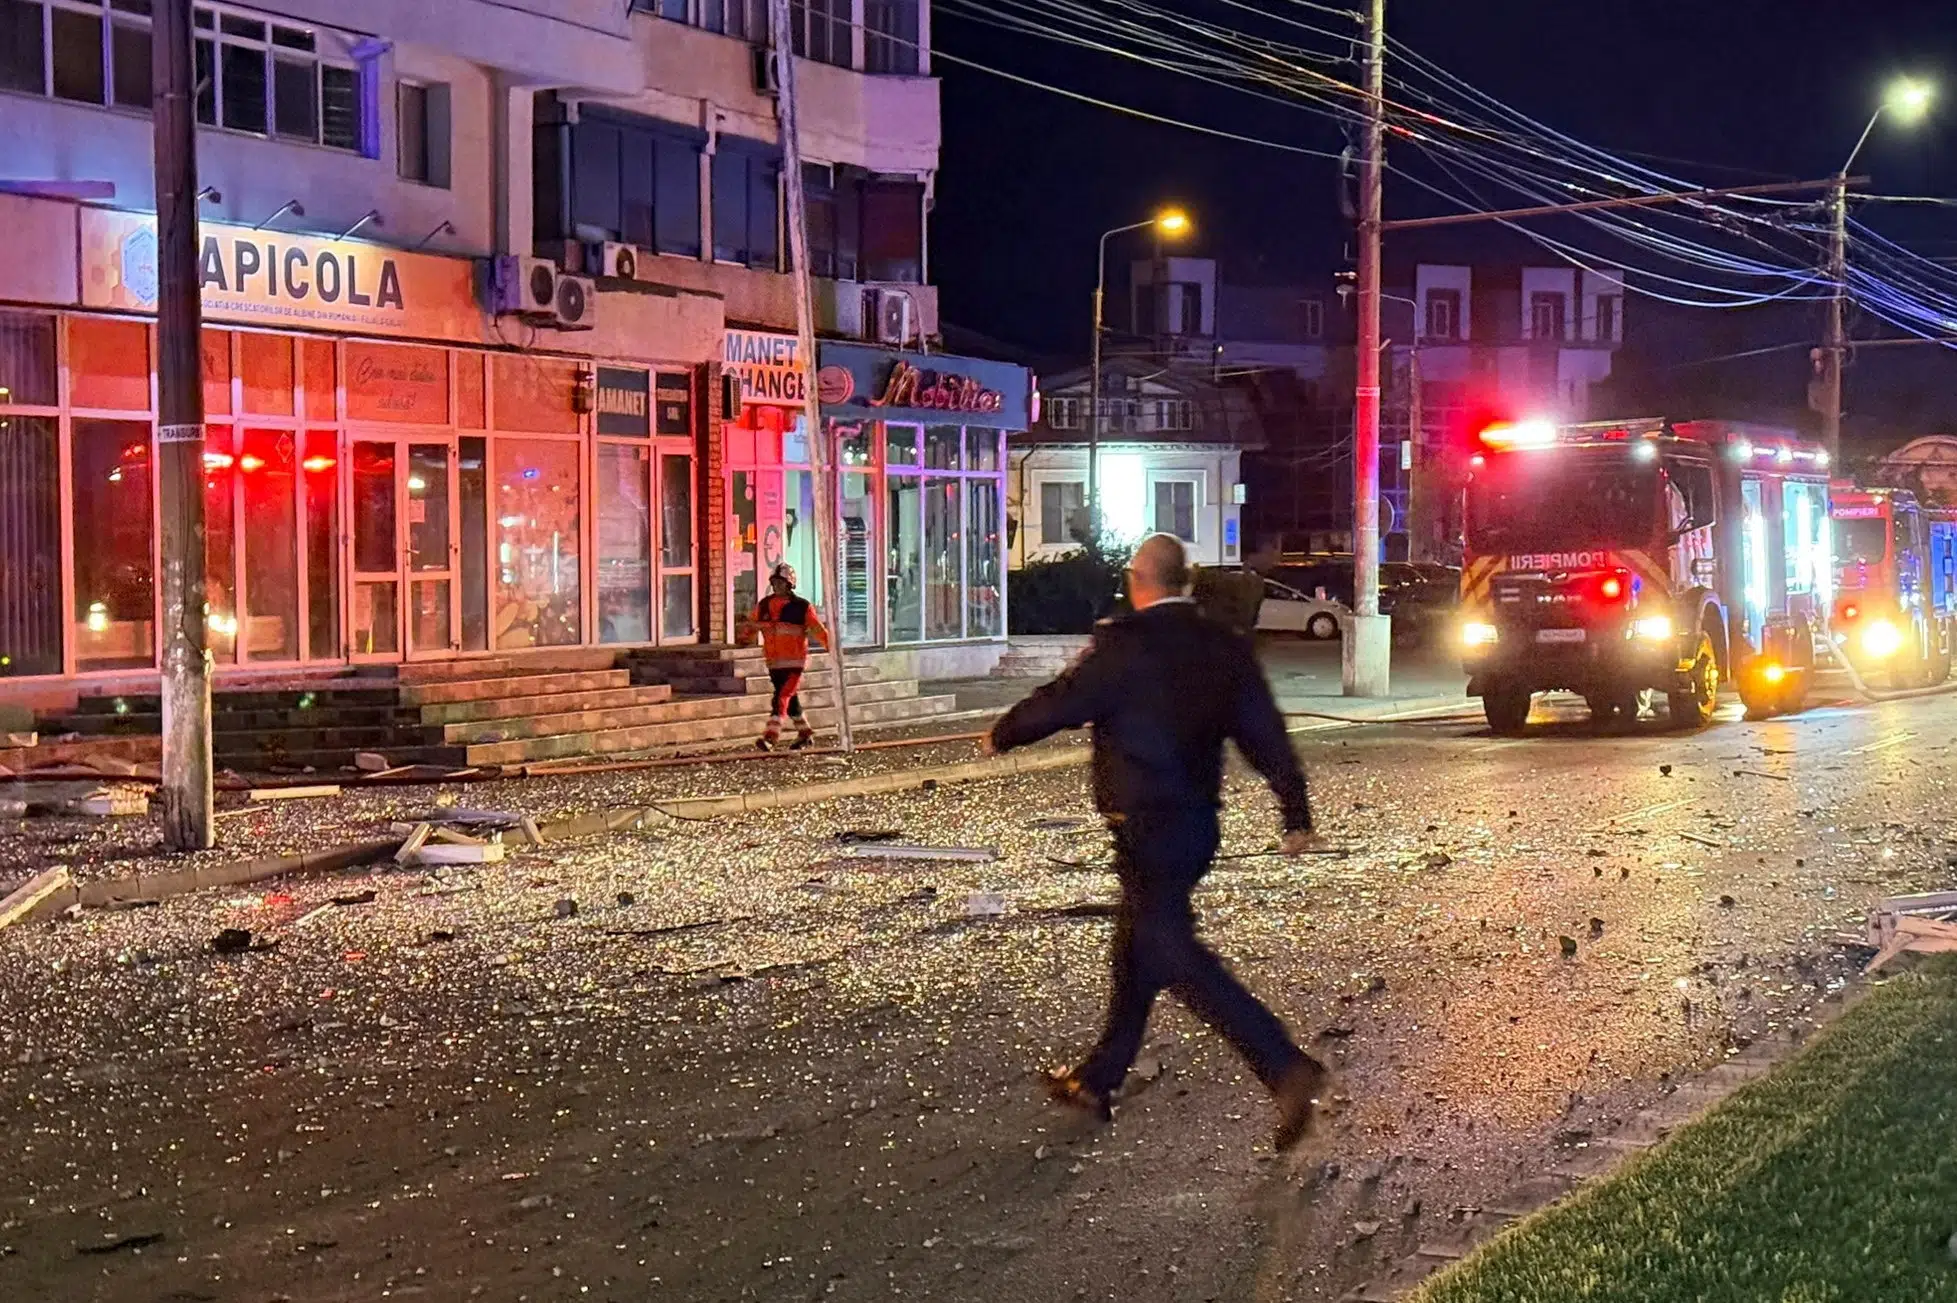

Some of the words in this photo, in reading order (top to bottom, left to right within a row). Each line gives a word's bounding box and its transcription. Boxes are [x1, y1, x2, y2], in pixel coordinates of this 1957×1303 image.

[200, 236, 404, 310] APICOLA
[726, 333, 797, 367] MANET
[598, 387, 646, 417] AMANET
